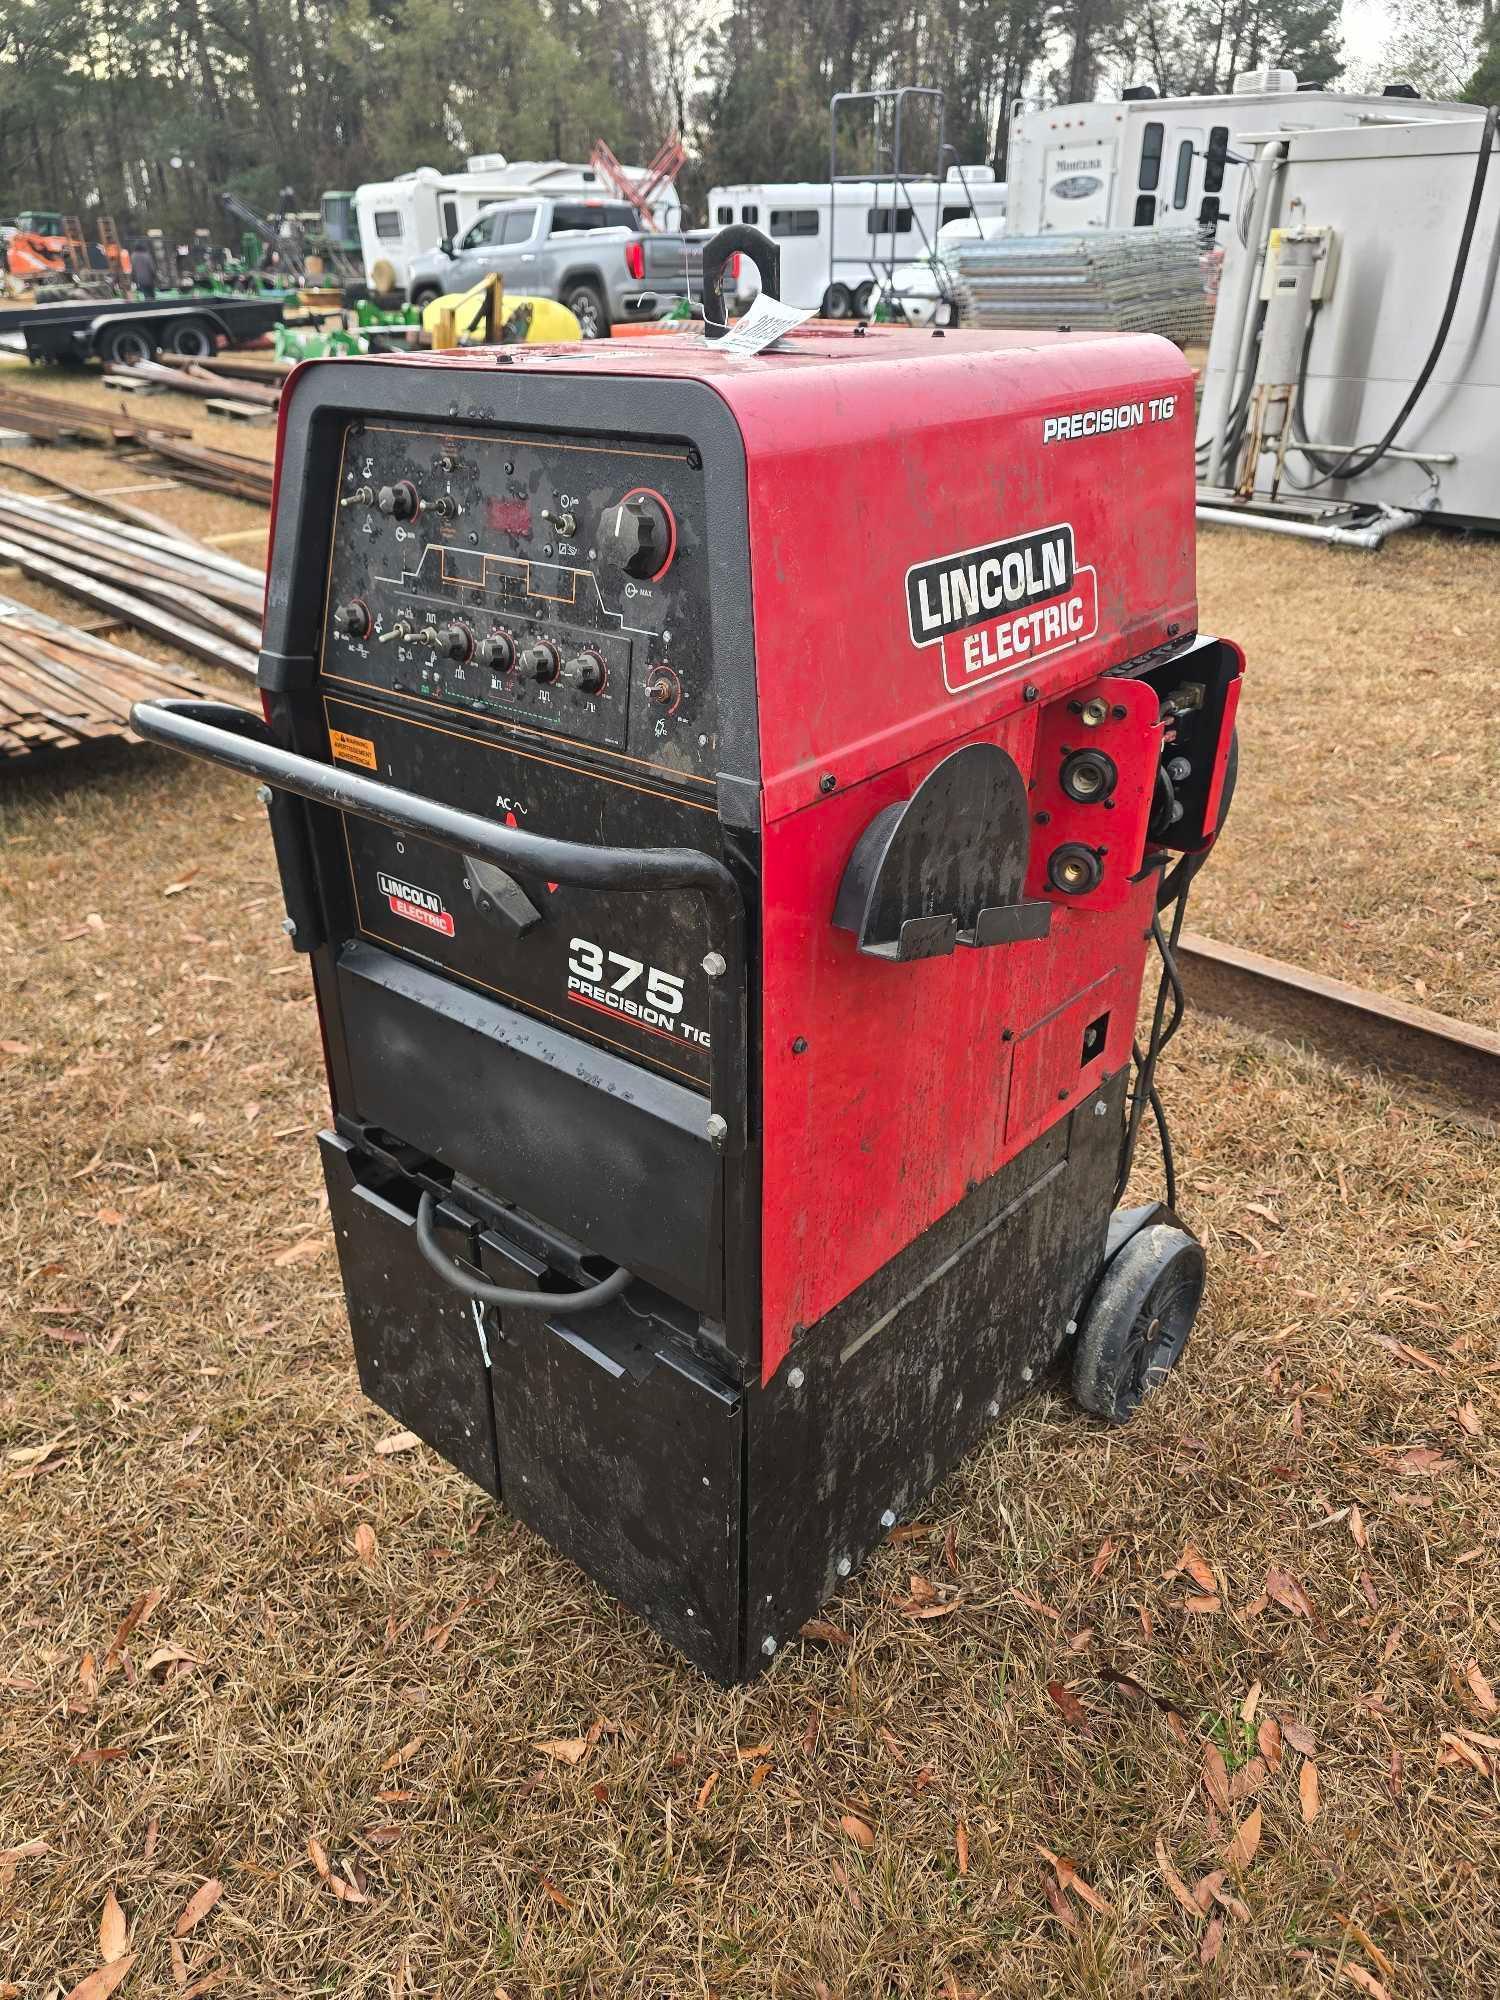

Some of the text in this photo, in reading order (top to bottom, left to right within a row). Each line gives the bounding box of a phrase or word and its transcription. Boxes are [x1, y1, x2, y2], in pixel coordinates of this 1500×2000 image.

[1043, 398, 1175, 444] PRECISION TIG
[918, 538, 1067, 631] LINCOLN
[963, 597, 1084, 673] ELECTRIC
[381, 876, 440, 913] LINCOLN
[397, 900, 447, 930] ELECTRIC
[568, 937, 685, 1014] 375
[567, 976, 675, 1032] PRECISION
